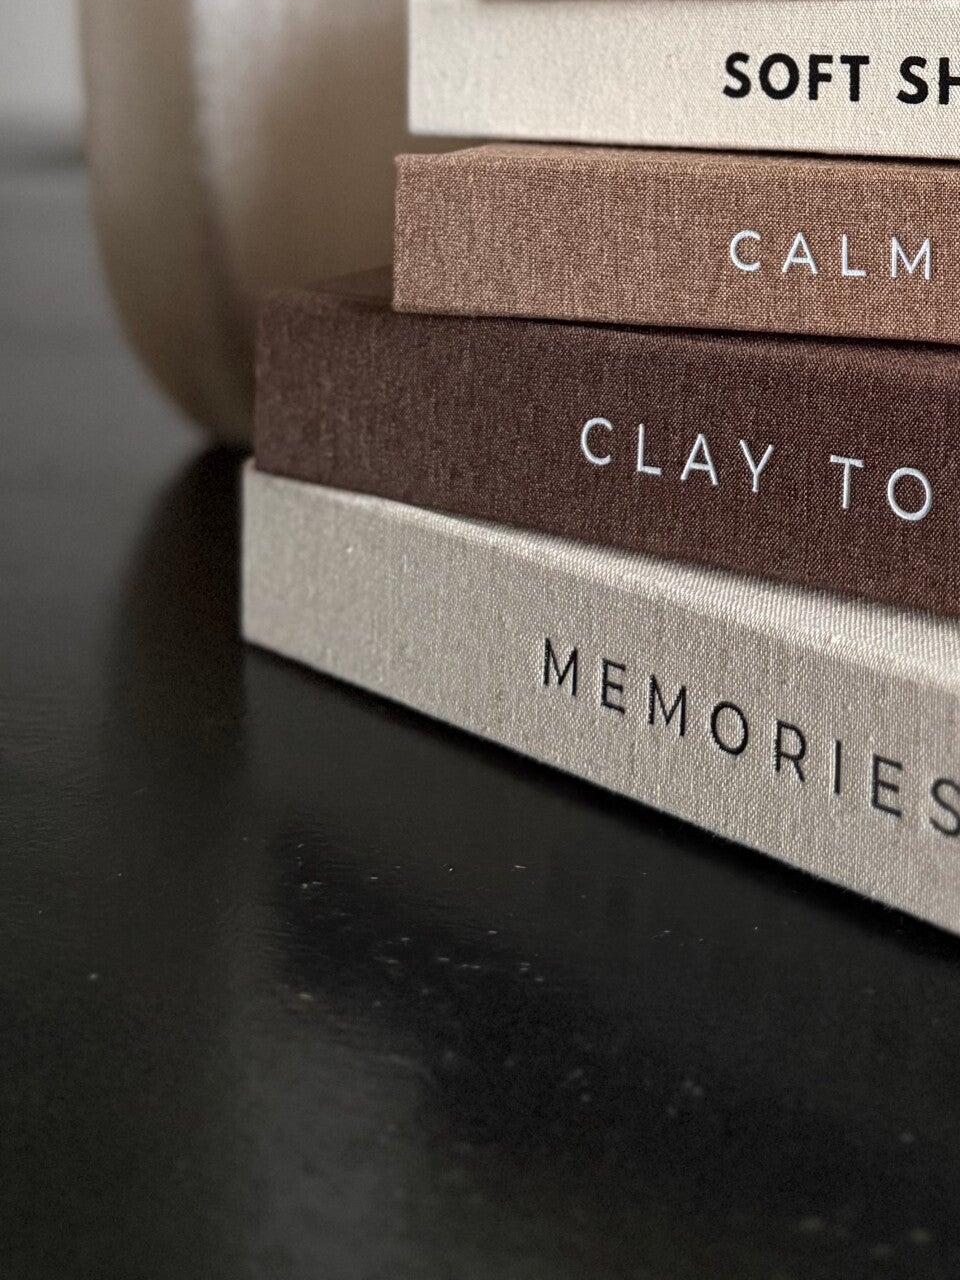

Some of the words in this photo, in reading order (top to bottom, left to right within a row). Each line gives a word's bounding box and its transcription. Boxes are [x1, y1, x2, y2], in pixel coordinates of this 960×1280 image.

[722, 51, 870, 102] SOFT
[728, 229, 933, 281] CALM
[579, 417, 774, 493] CLAY
